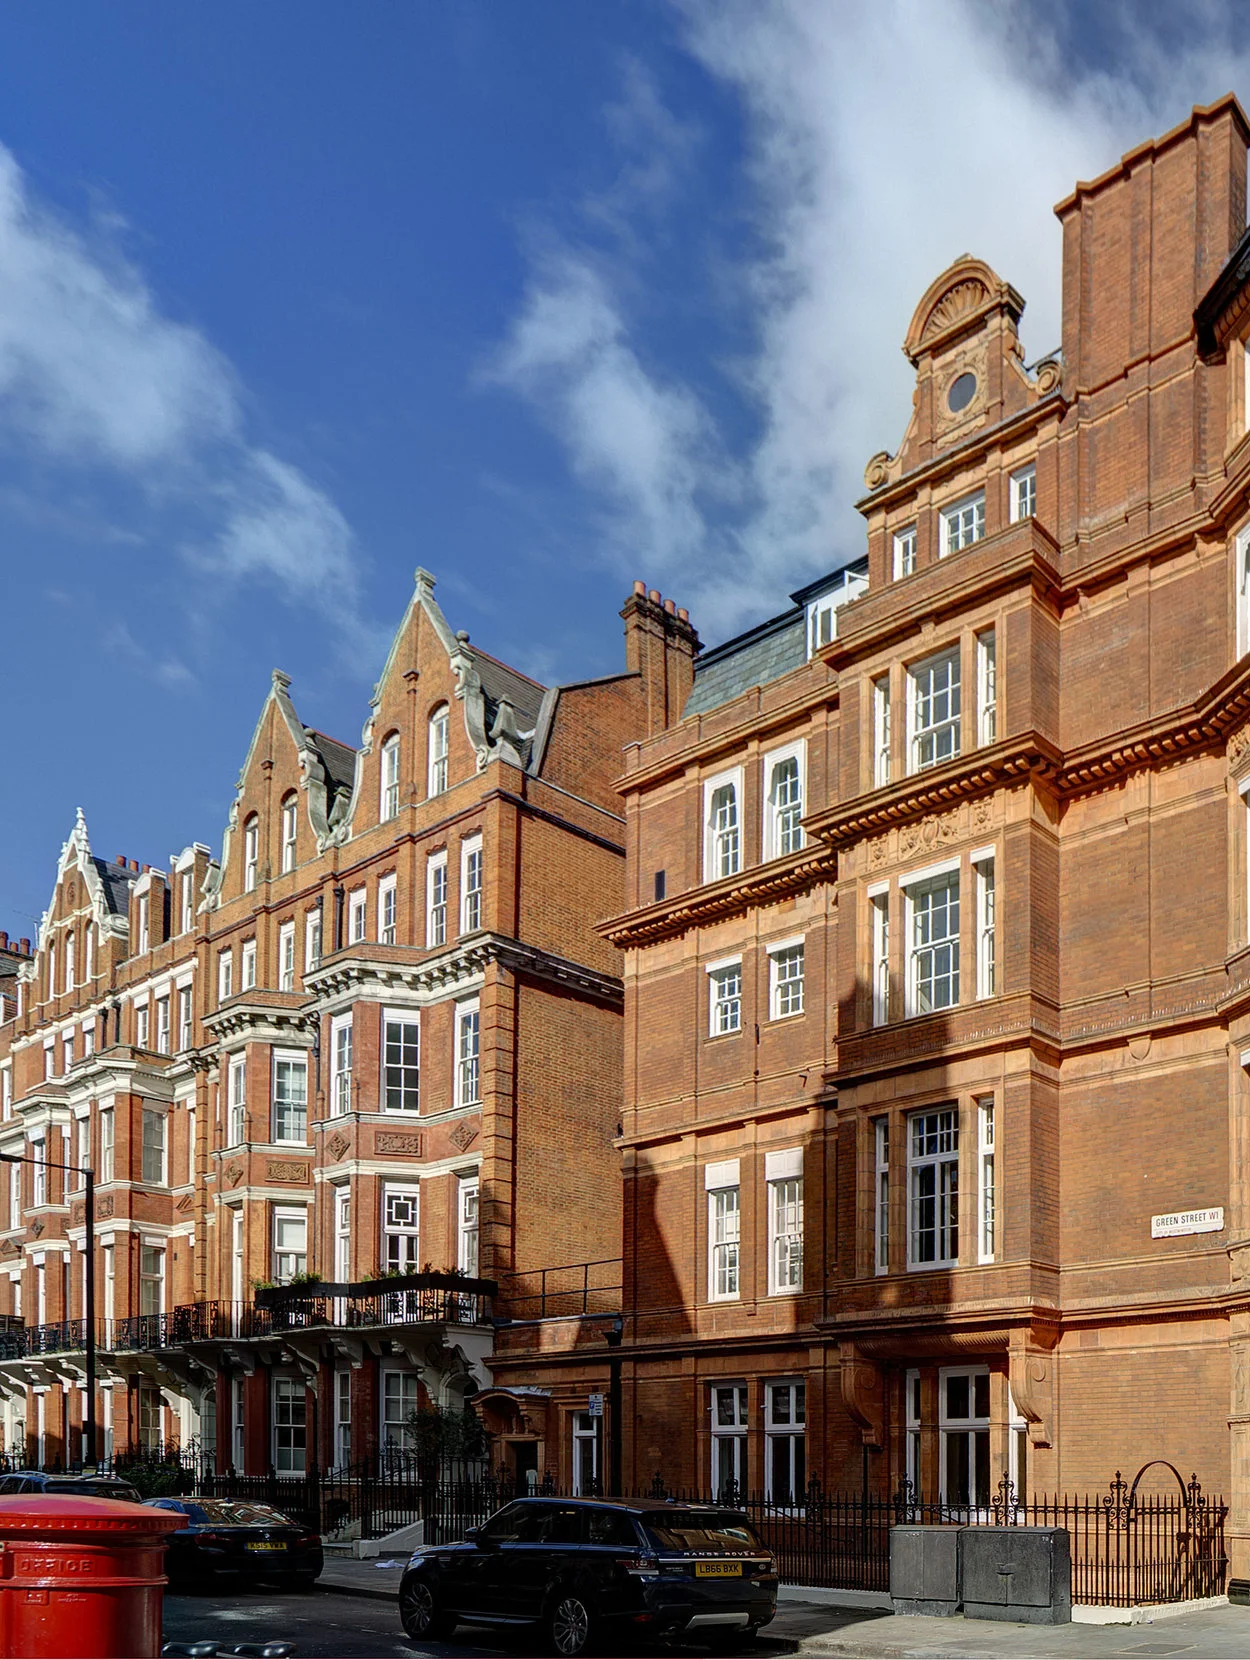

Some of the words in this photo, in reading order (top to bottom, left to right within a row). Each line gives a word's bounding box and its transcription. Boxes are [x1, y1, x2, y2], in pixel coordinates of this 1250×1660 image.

[1155, 1216, 1179, 1227] GREEN
[1181, 1212, 1206, 1224] STREET
[1209, 1211, 1219, 1220] W1
[21, 1558, 94, 1573] OFFICE
[700, 1564, 721, 1573] LB66
[723, 1564, 739, 1573] BXK
